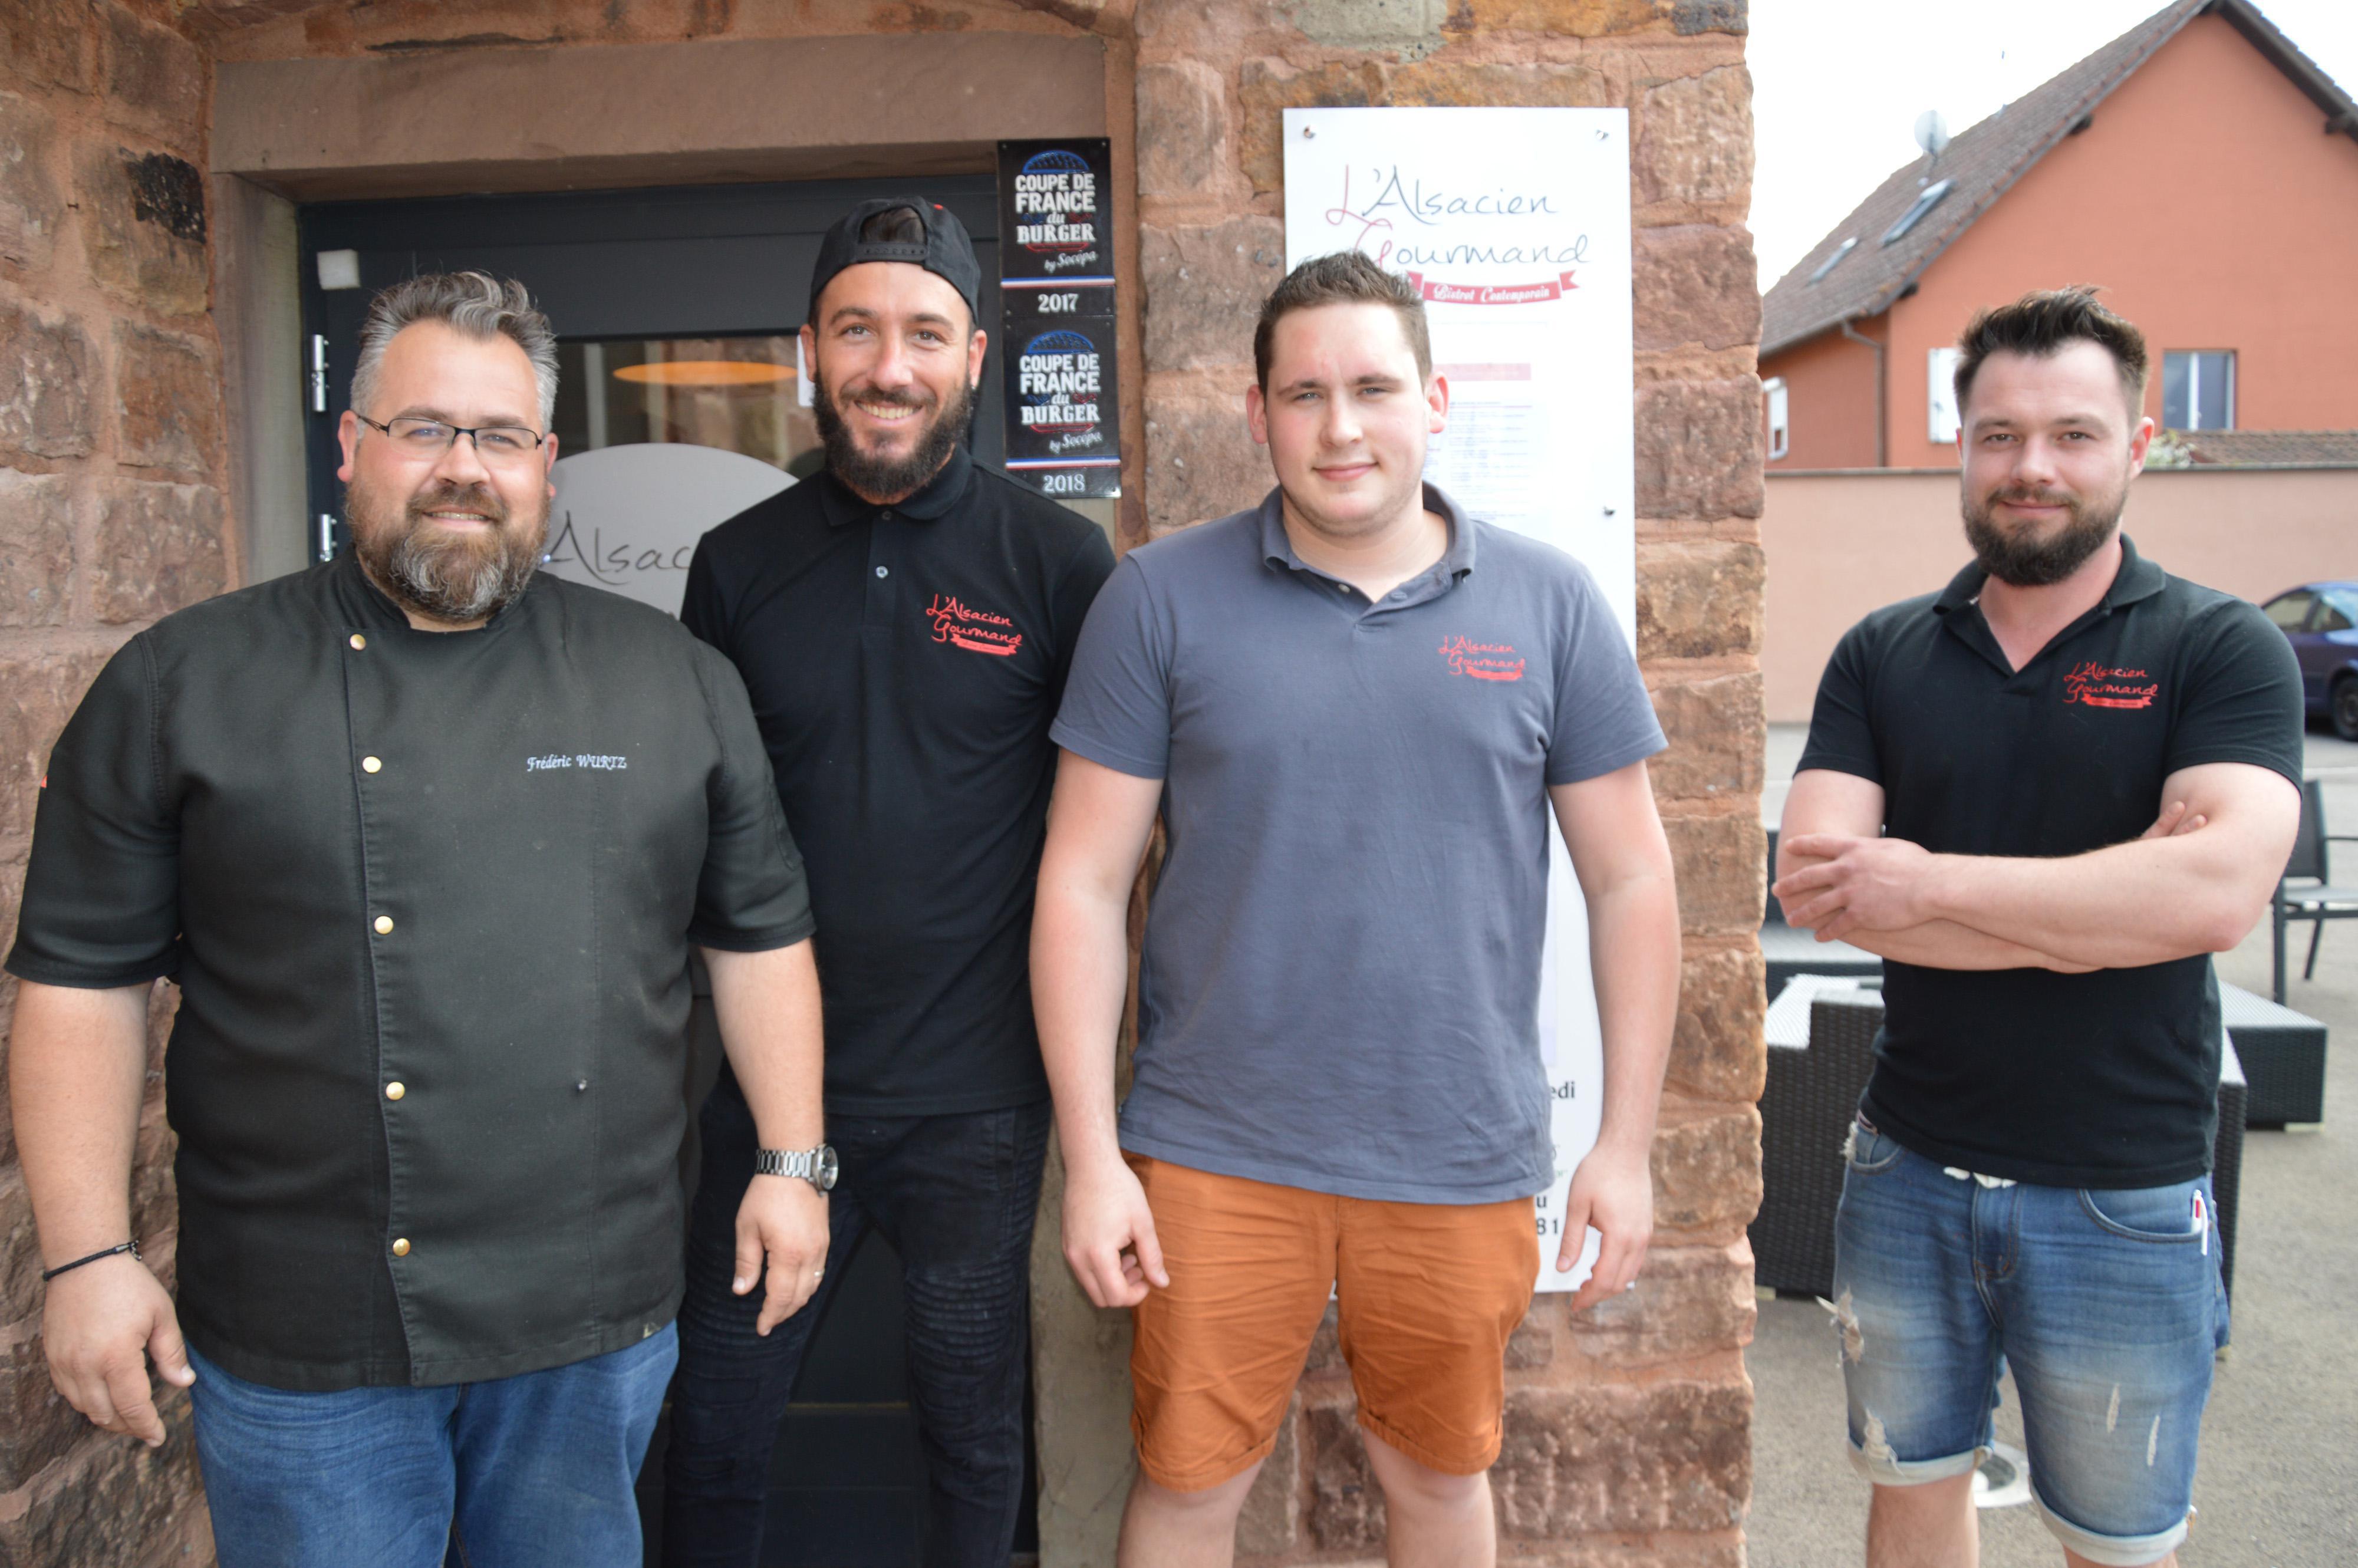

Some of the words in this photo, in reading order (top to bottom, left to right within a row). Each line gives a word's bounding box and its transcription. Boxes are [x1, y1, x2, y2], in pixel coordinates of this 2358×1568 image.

[1015, 173, 1070, 192] COUPE
[1073, 173, 1096, 190] DE
[1015, 190, 1096, 213] FRANCE
[1325, 163, 1559, 226] L'Alsacien
[1046, 212, 1066, 224] du
[1016, 223, 1096, 243] BURGER
[1354, 218, 1590, 271] Gourmand
[1044, 259, 1056, 273] by
[1058, 251, 1097, 267] Socopa
[1038, 293, 1079, 312] 2017
[1434, 284, 1475, 301] Bistrot
[1480, 285, 1550, 303] Contemporain
[1020, 354, 1074, 373] COUPE
[1078, 353, 1100, 371] DE
[1020, 371, 1101, 394] FRANCE
[1051, 392, 1070, 405] du
[1020, 404, 1101, 424] BURGER
[1049, 440, 1061, 454] by
[1062, 431, 1102, 447] Socopa
[1043, 473, 1085, 493] 2018
[540, 510, 690, 585] Alsac
[926, 594, 1013, 627] L'Alsacien
[931, 614, 1023, 642] Gourmand
[1438, 635, 1516, 655] L'Alsacien
[1448, 650, 1526, 675] Gourmand
[2063, 661, 2149, 682] L'Alsacien
[2063, 676, 2159, 703] Gourmand
[526, 753, 572, 772] Frédéric
[576, 753, 627, 770] WURTZ
[1550, 1081, 1575, 1099] edi
[1536, 1195, 1547, 1208] u
